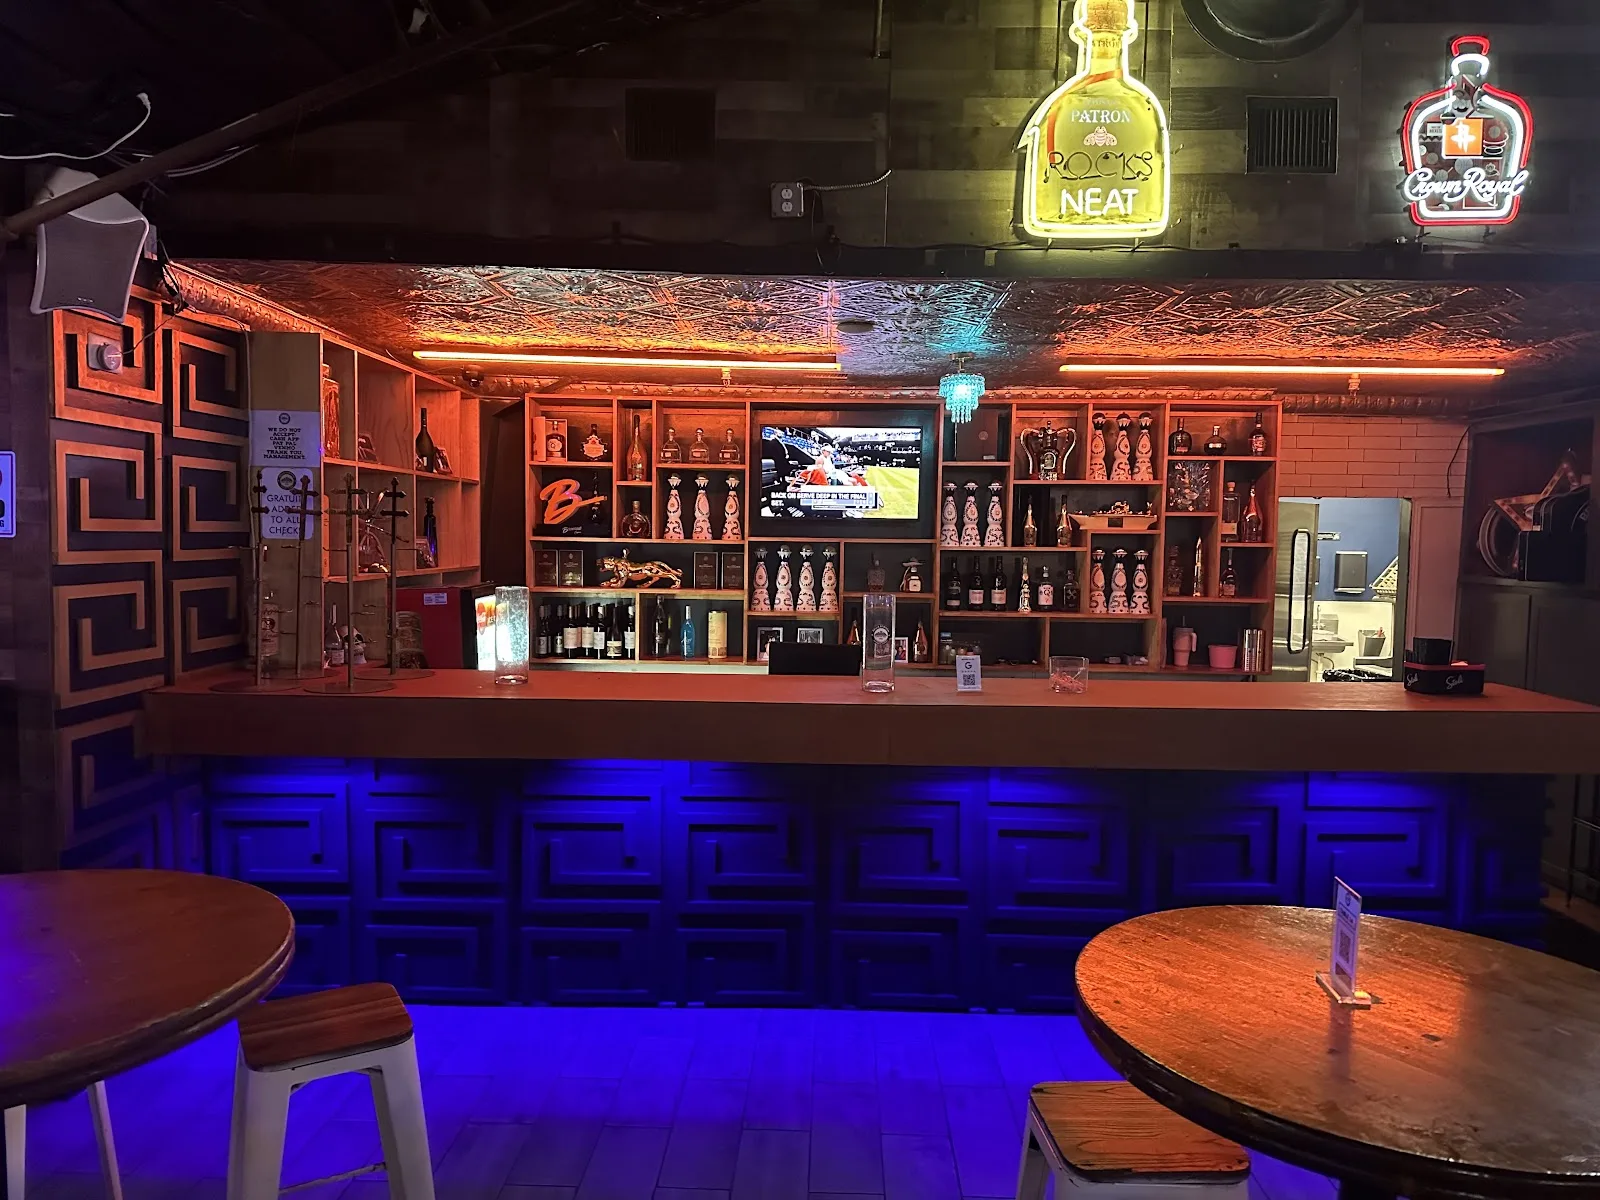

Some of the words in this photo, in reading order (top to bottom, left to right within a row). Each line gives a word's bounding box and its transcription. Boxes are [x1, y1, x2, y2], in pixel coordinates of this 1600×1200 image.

[1045, 151, 1153, 181] ROCKS
[1404, 167, 1462, 202] Crown
[1059, 187, 1139, 217] NEAT
[271, 516, 283, 524] TO
